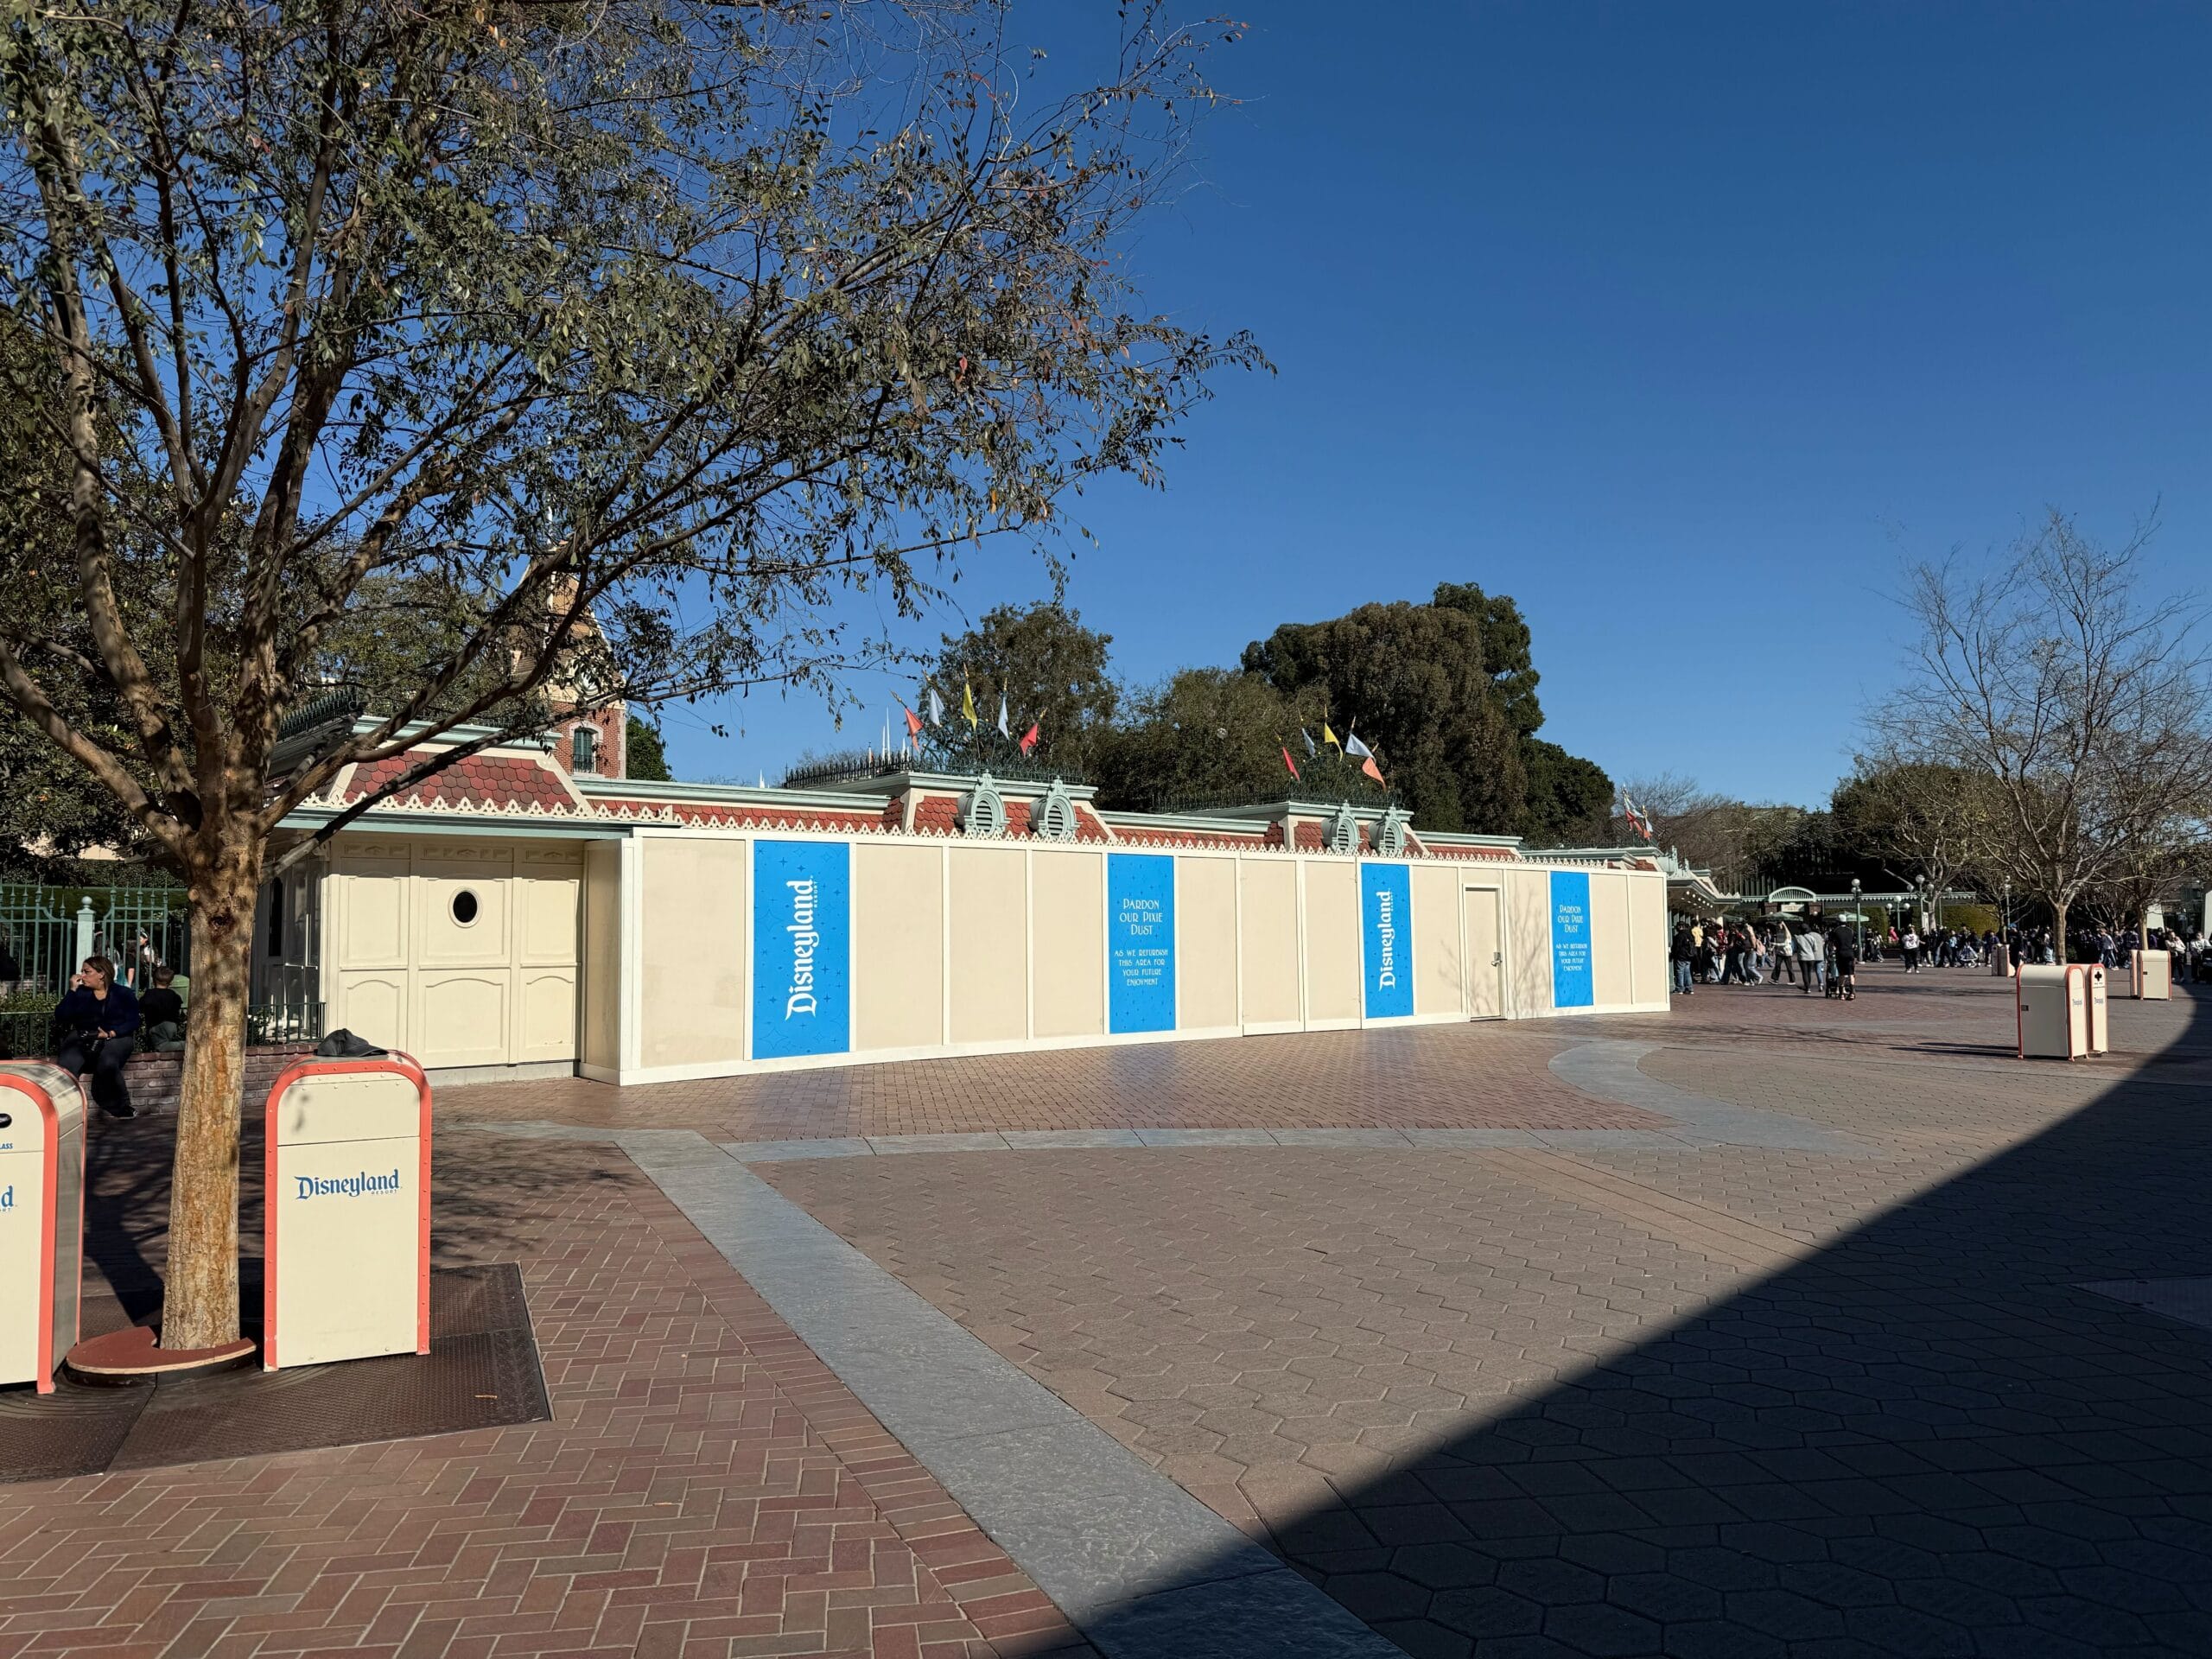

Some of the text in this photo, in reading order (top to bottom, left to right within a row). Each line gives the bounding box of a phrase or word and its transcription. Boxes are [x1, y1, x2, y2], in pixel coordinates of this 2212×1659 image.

[1123, 898, 1160, 910] PARDON
[1119, 912, 1163, 923] OUR PIXIE
[1131, 924, 1153, 935] DUST
[1376, 891, 1395, 992] Disneyland
[785, 879, 820, 1021] Disneyland
[1127, 977, 1158, 987] ENJOYMENT
[294, 1168, 399, 1200] Disneyland
